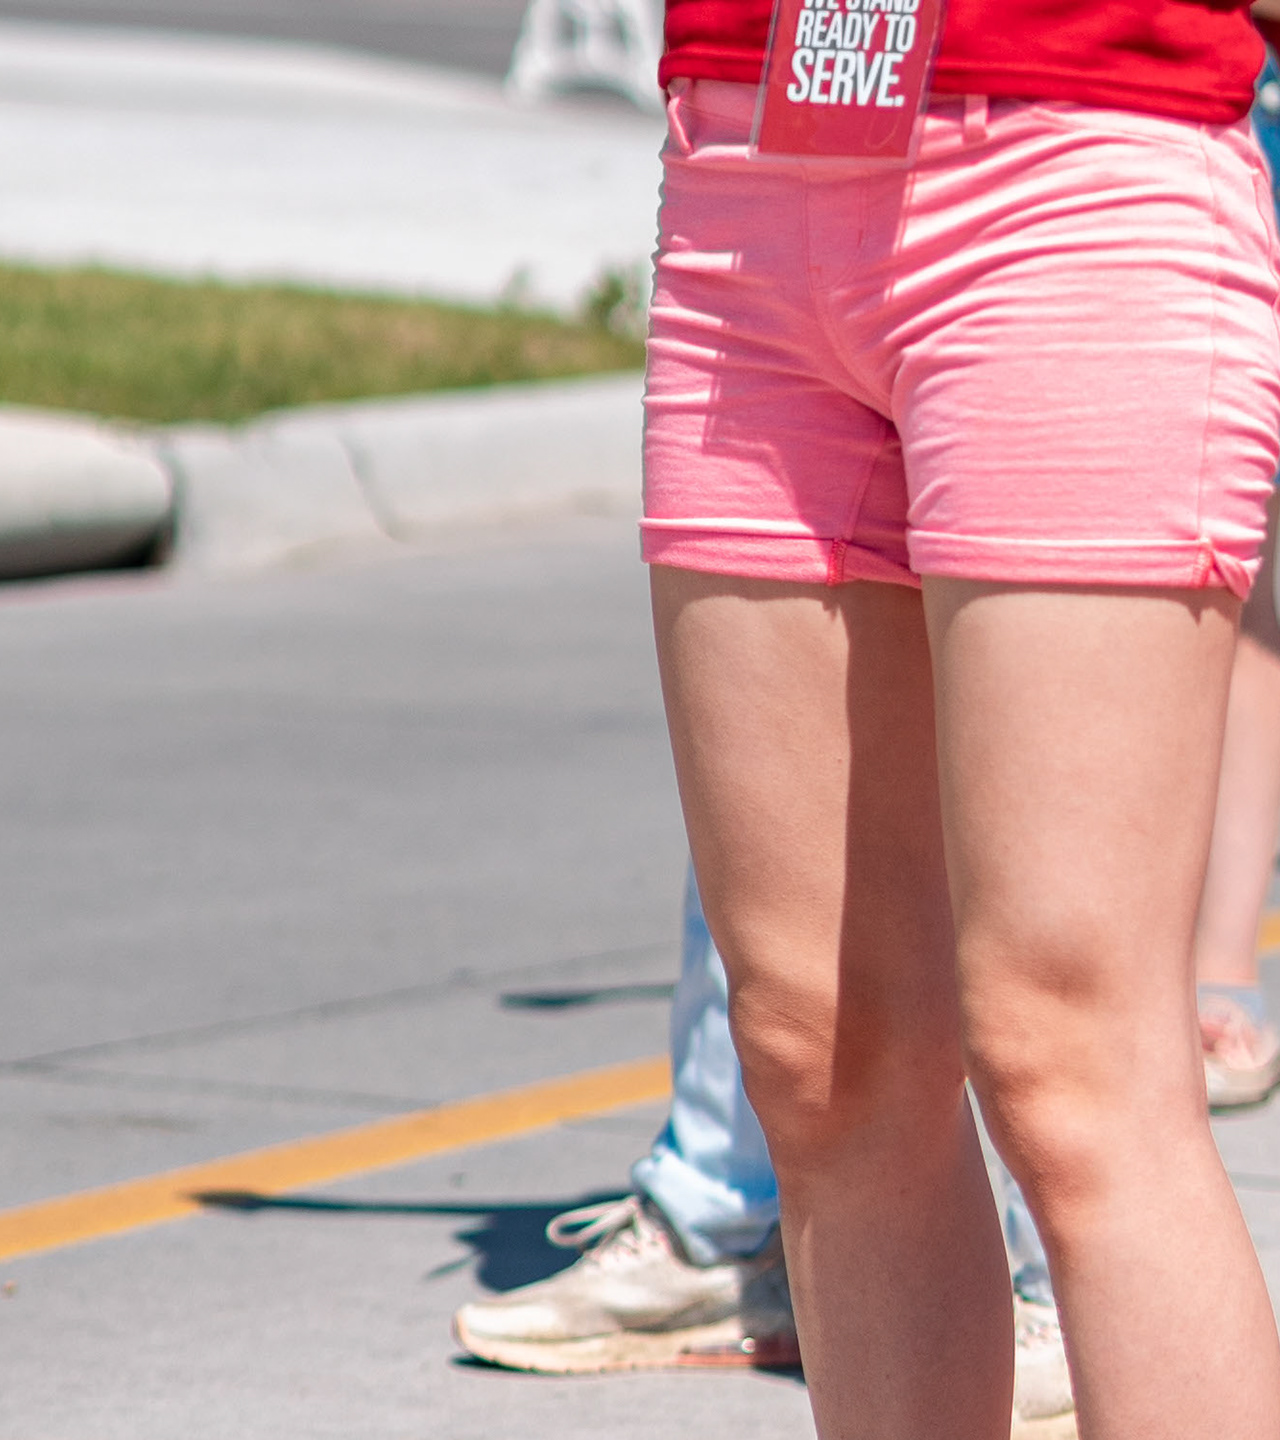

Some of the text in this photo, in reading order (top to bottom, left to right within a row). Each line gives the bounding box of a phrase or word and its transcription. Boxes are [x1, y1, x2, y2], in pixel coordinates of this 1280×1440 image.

[795, 9, 916, 52] READY TO
[786, 48, 905, 107] SERVE.
